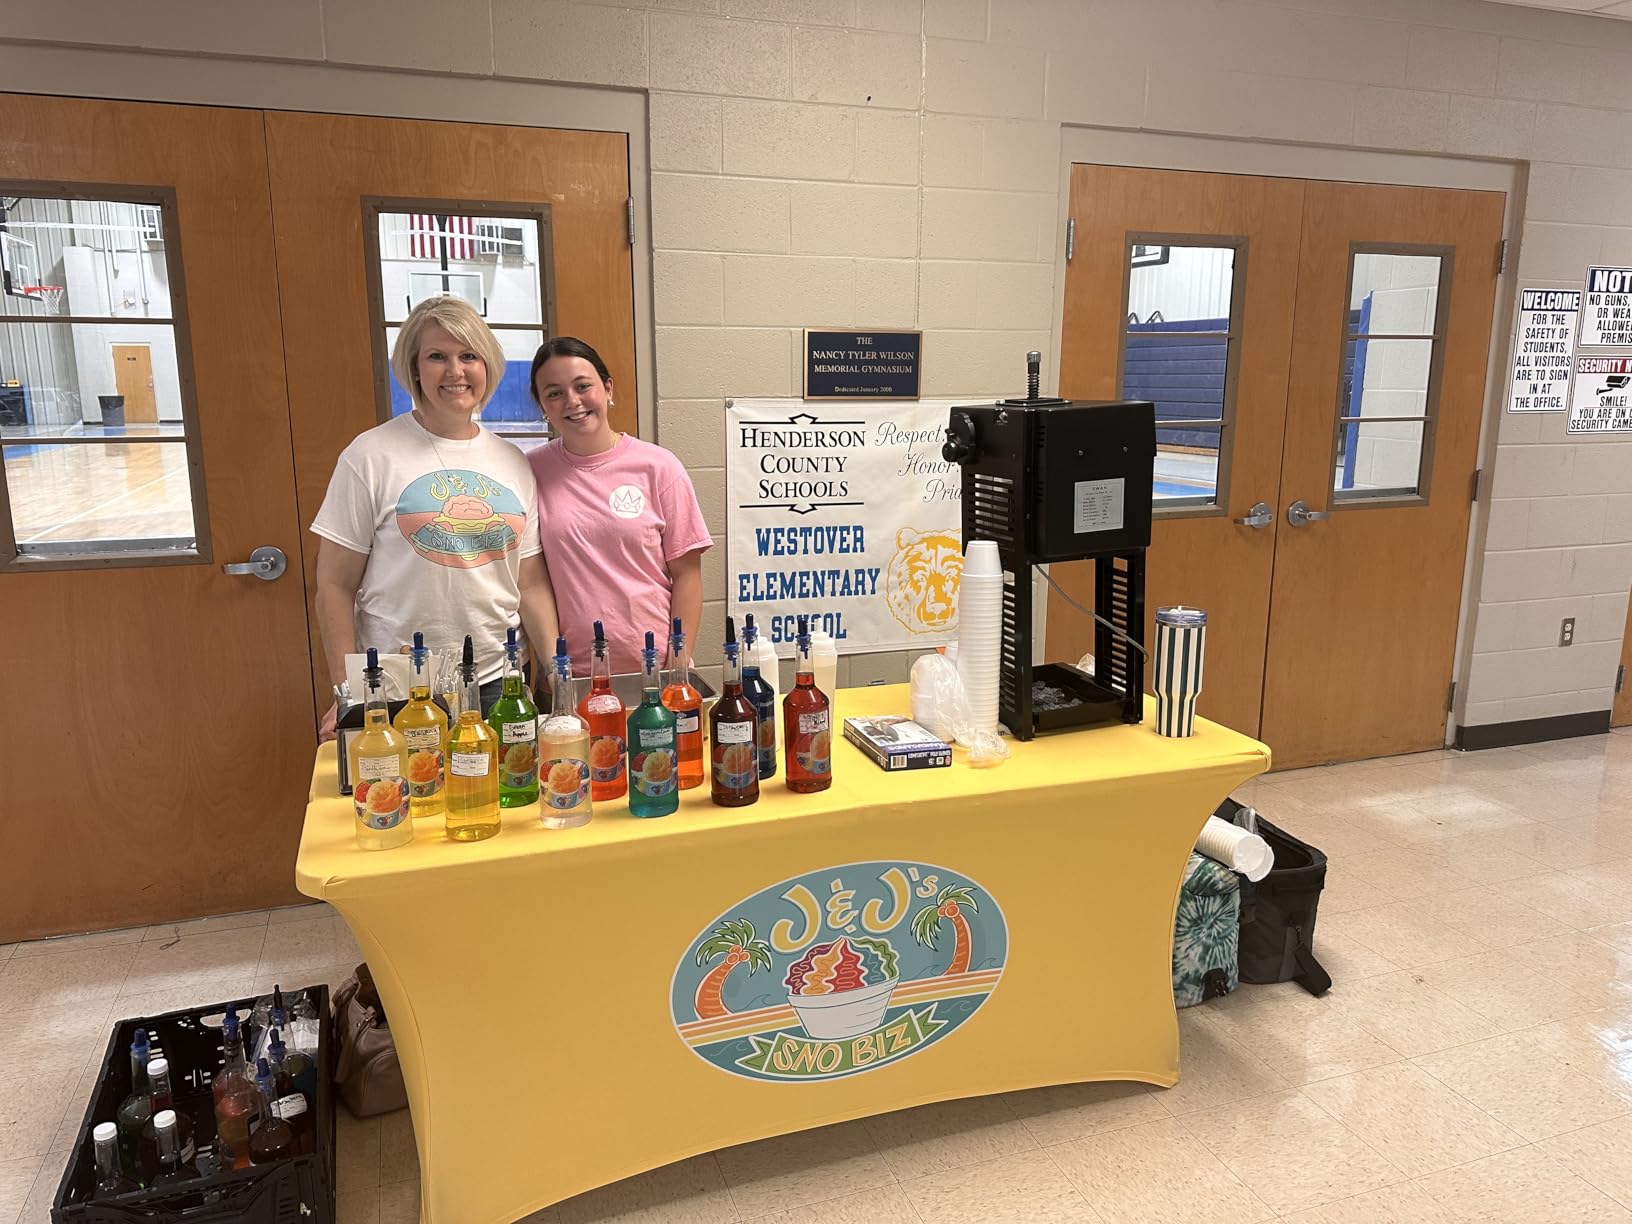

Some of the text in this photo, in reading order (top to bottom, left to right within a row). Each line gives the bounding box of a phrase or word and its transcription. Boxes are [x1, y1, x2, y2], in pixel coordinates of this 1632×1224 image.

[1523, 292, 1579, 310] WELCOME
[1589, 294, 1630, 307] NO GUNS,
[1597, 307, 1632, 319] OR WEA
[1532, 314, 1566, 325] FOR THE
[1597, 320, 1632, 331] ALLOWE
[1525, 328, 1569, 339] SAFETY OF
[856, 337, 873, 345] THE
[1523, 341, 1567, 354] STUDENTS,
[813, 350, 914, 360] NANCY TYLER WILSON
[1516, 356, 1571, 367] ALL VISITORS
[1578, 359, 1623, 373] SECURITY
[814, 365, 912, 373] MEMORIAL GYMNASIUM
[1515, 370, 1568, 380] ARE TO SIGN
[1529, 383, 1552, 394] IN AT
[1515, 397, 1563, 408] THE OFFICE.
[1600, 396, 1628, 407] SMILE!
[1579, 408, 1594, 419] YOU
[1597, 408, 1612, 419] ARE
[1615, 408, 1626, 418] ON
[1571, 419, 1609, 429] SECURITY
[740, 428, 866, 448] HENDERSON
[760, 454, 847, 473] COUNTY
[759, 479, 848, 498] SCHOOLS
[431, 530, 504, 551] SNO BIZ
[755, 525, 865, 556] WESTOVER
[738, 568, 881, 602] ELEMENTARY
[769, 867, 939, 954] J & J's
[773, 1021, 911, 1073] SNO BIZ
